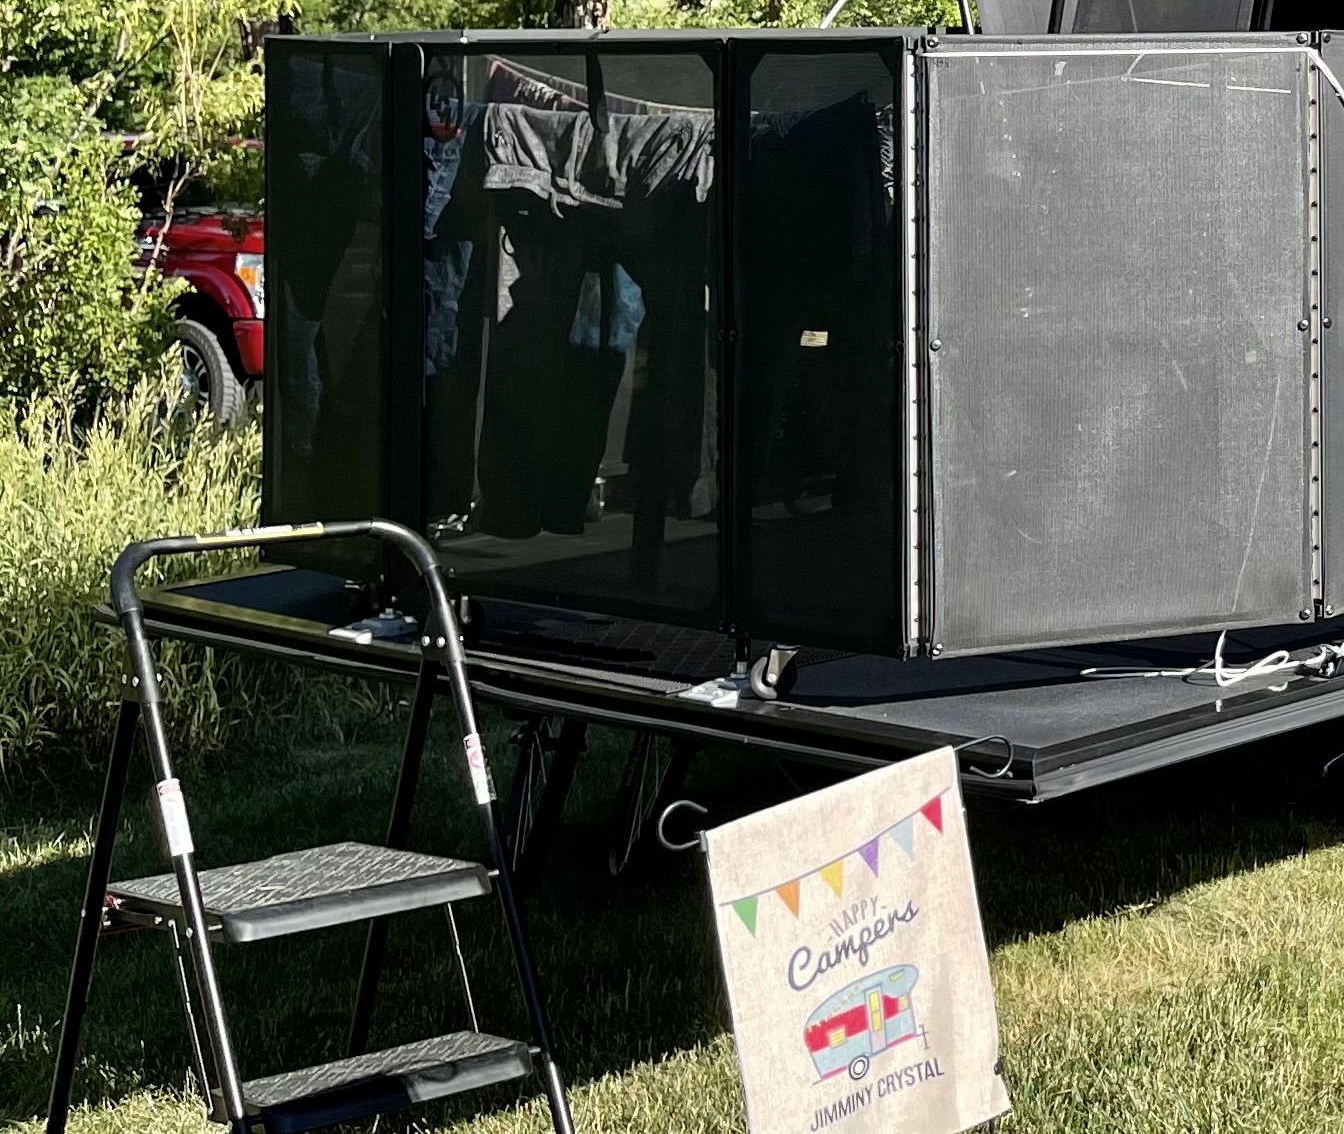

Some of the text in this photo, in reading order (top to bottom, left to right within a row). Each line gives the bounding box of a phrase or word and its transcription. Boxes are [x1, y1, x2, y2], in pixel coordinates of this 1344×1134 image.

[788, 900, 919, 991] Campers
[829, 895, 878, 937] HAPPY
[810, 1058, 944, 1132] JIMMINY CRYSTAL
